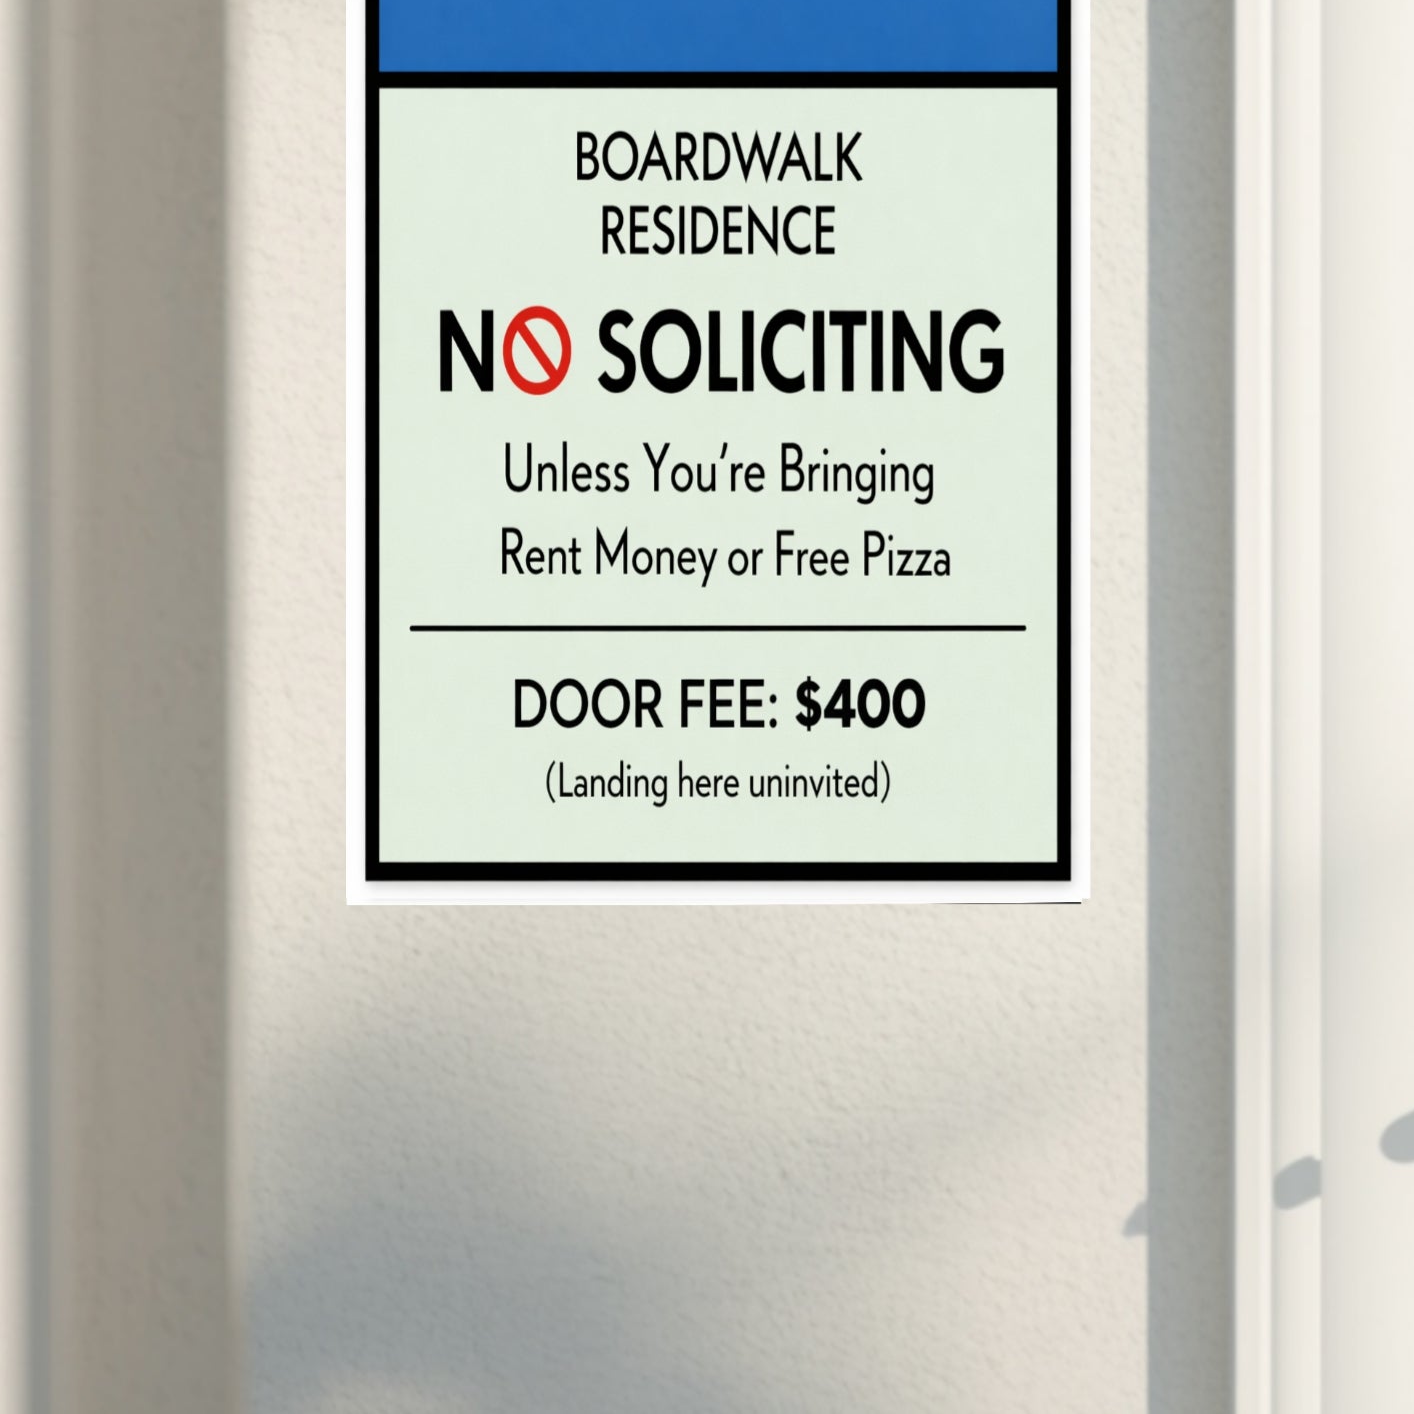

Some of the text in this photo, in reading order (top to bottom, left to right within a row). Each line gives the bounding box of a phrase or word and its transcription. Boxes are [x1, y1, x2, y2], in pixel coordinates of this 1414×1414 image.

[576, 130, 863, 184] BOARDWALK
[601, 204, 836, 256] RESIDENCE
[597, 308, 1005, 395] SOLICITING
[504, 440, 934, 506] Unless You’re Bringing
[501, 526, 951, 588] Rent Money or Free Pizza
[514, 675, 926, 732] DOOR FEE: $400
[545, 759, 891, 808] (Landing here uninvited)
